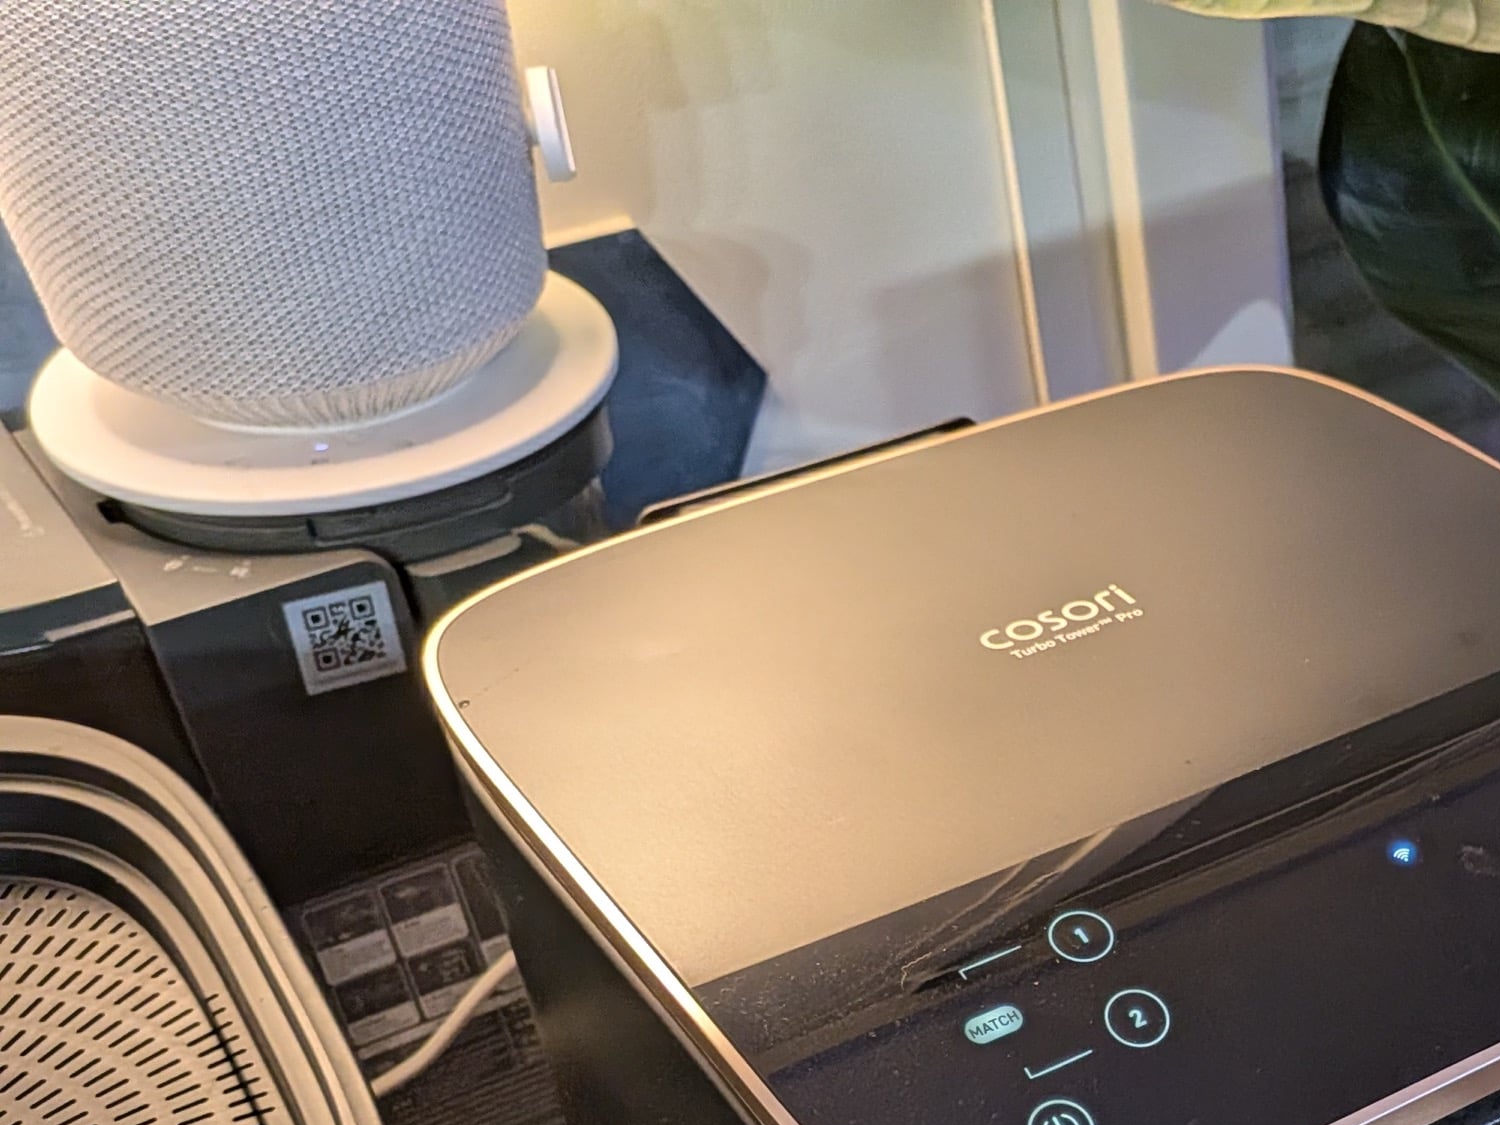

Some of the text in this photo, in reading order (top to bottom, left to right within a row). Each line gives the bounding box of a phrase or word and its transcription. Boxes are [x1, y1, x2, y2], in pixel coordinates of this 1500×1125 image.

[980, 584, 1136, 650] cosori
[1010, 639, 1055, 659] Turbo
[1114, 608, 1143, 622] Pro
[1074, 928, 1089, 943] 1
[968, 1010, 1019, 1039] MATCH
[1128, 1009, 1147, 1029] 2
